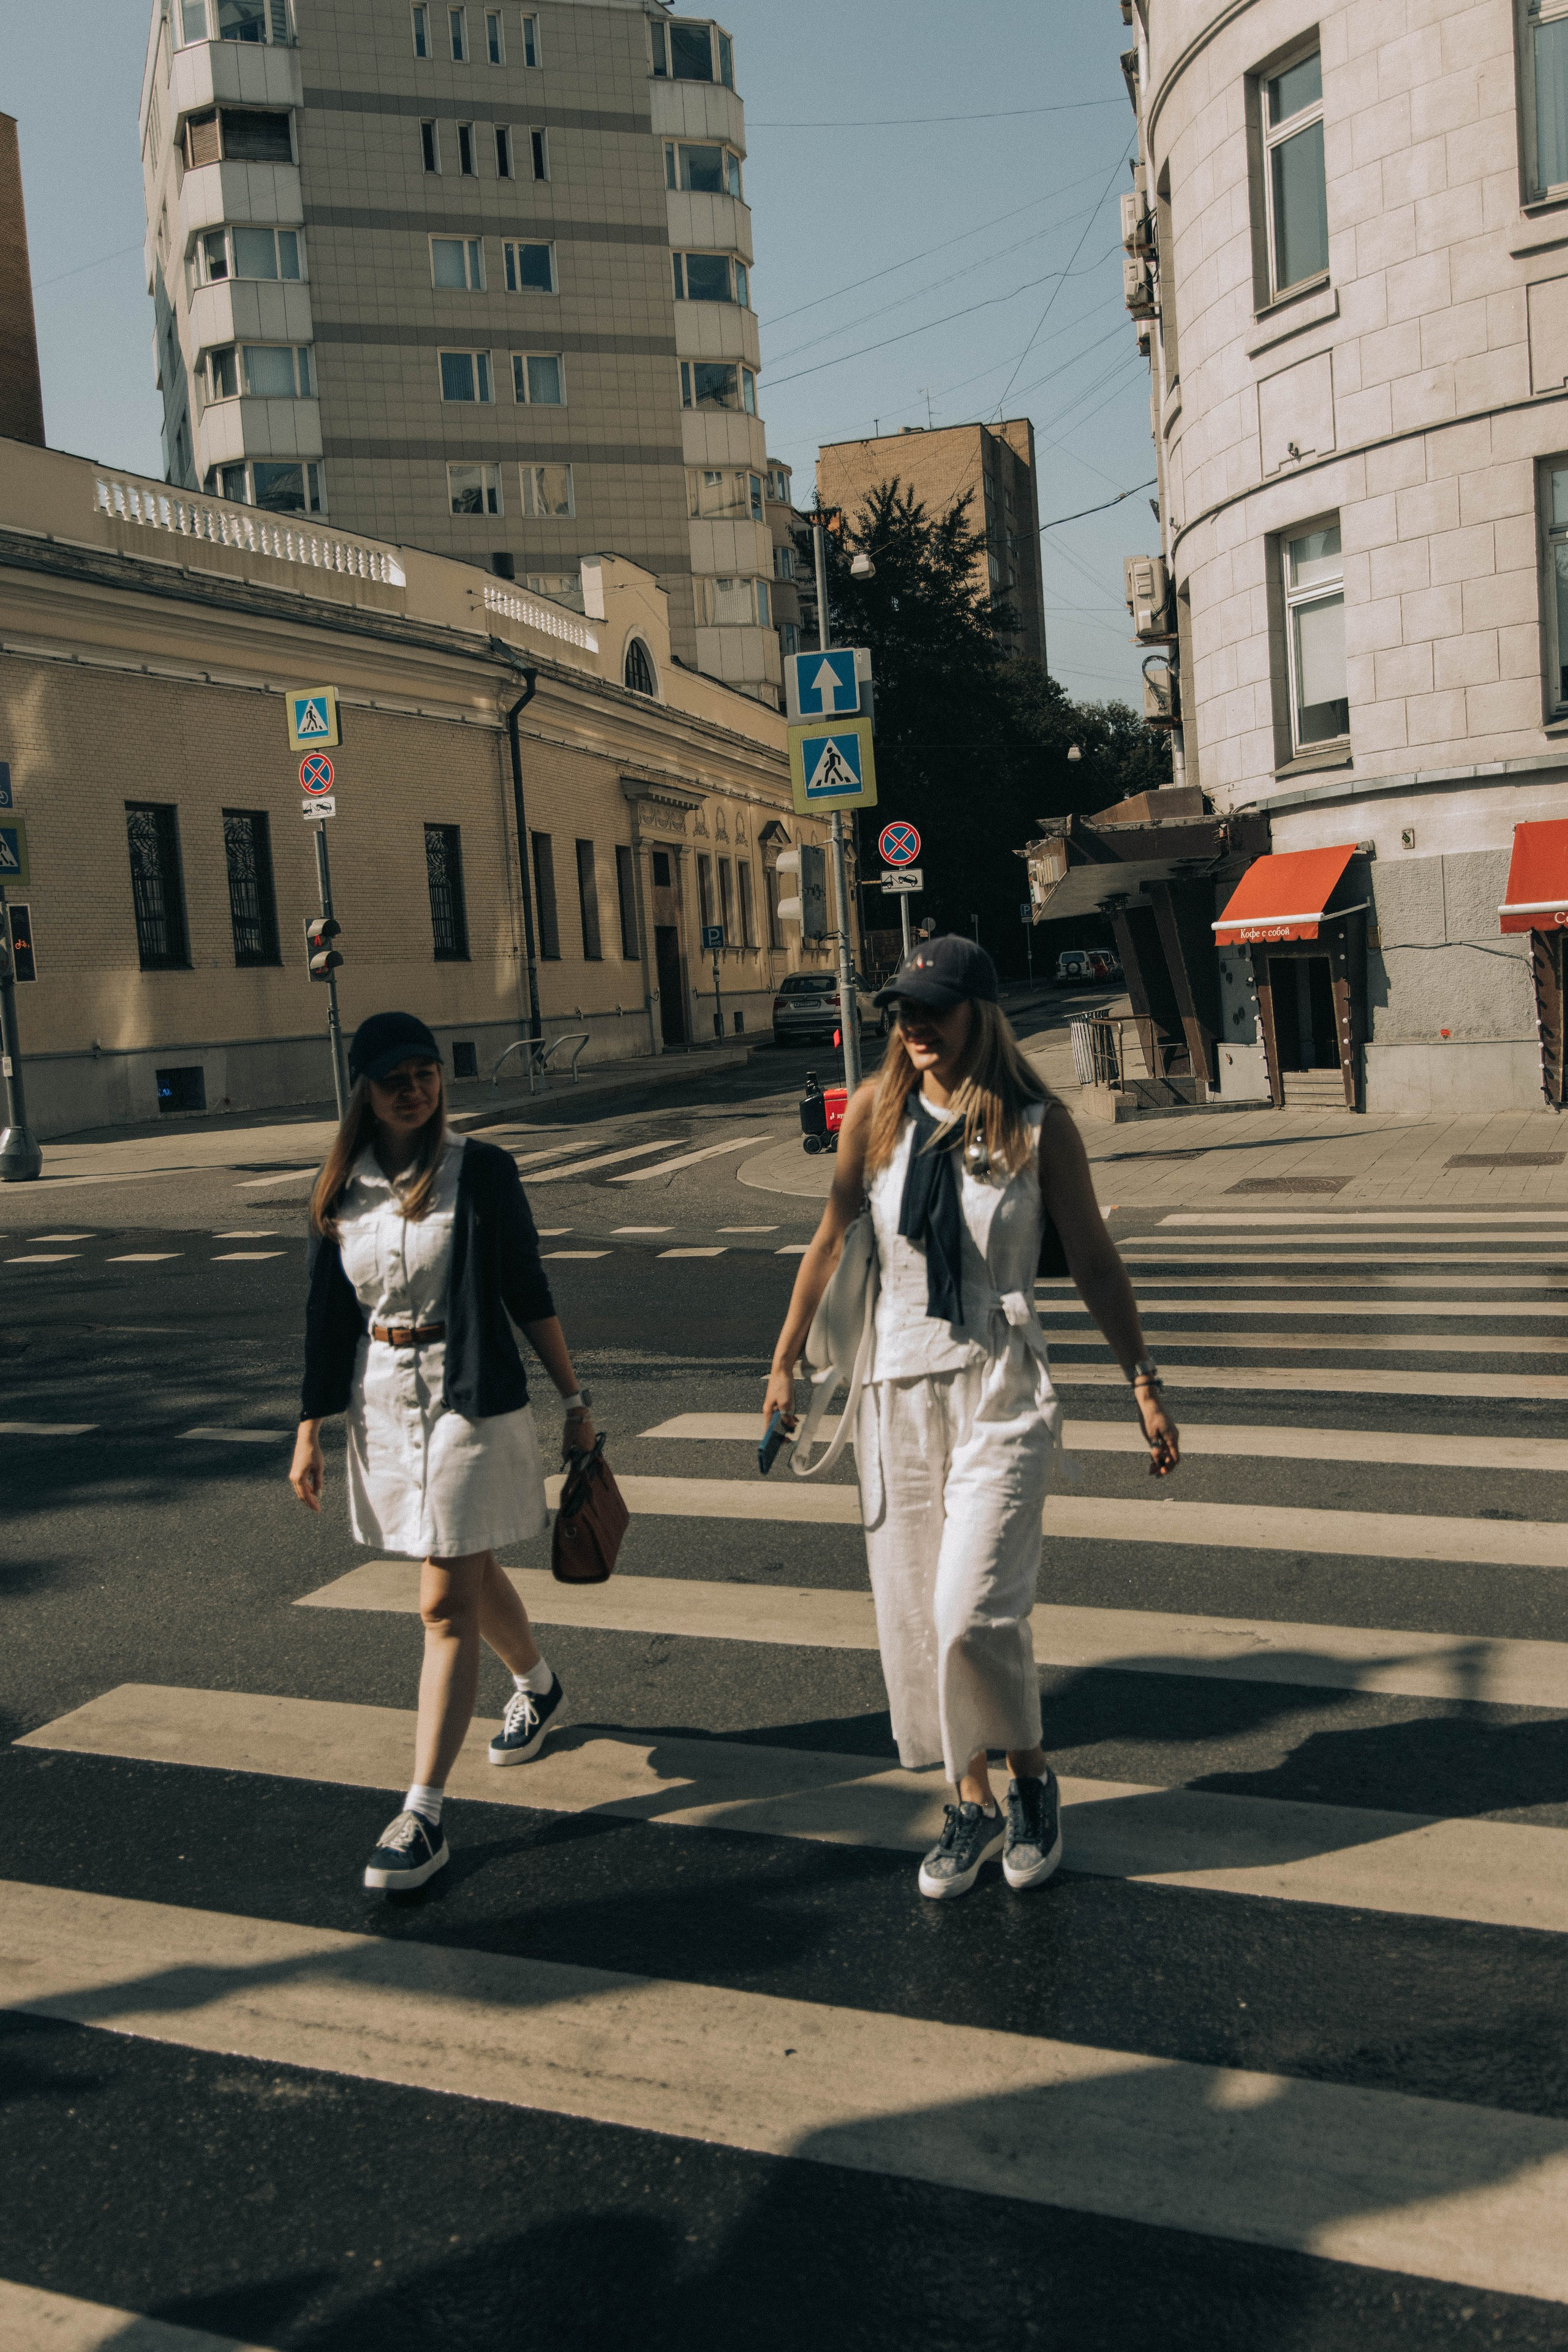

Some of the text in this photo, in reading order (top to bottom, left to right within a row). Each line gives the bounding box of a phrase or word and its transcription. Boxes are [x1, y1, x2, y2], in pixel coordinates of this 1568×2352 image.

[1023, 905, 1030, 914] P
[708, 928, 720, 946] P
[1240, 927, 1260, 940] Кофе
[1268, 926, 1289, 937] собой
